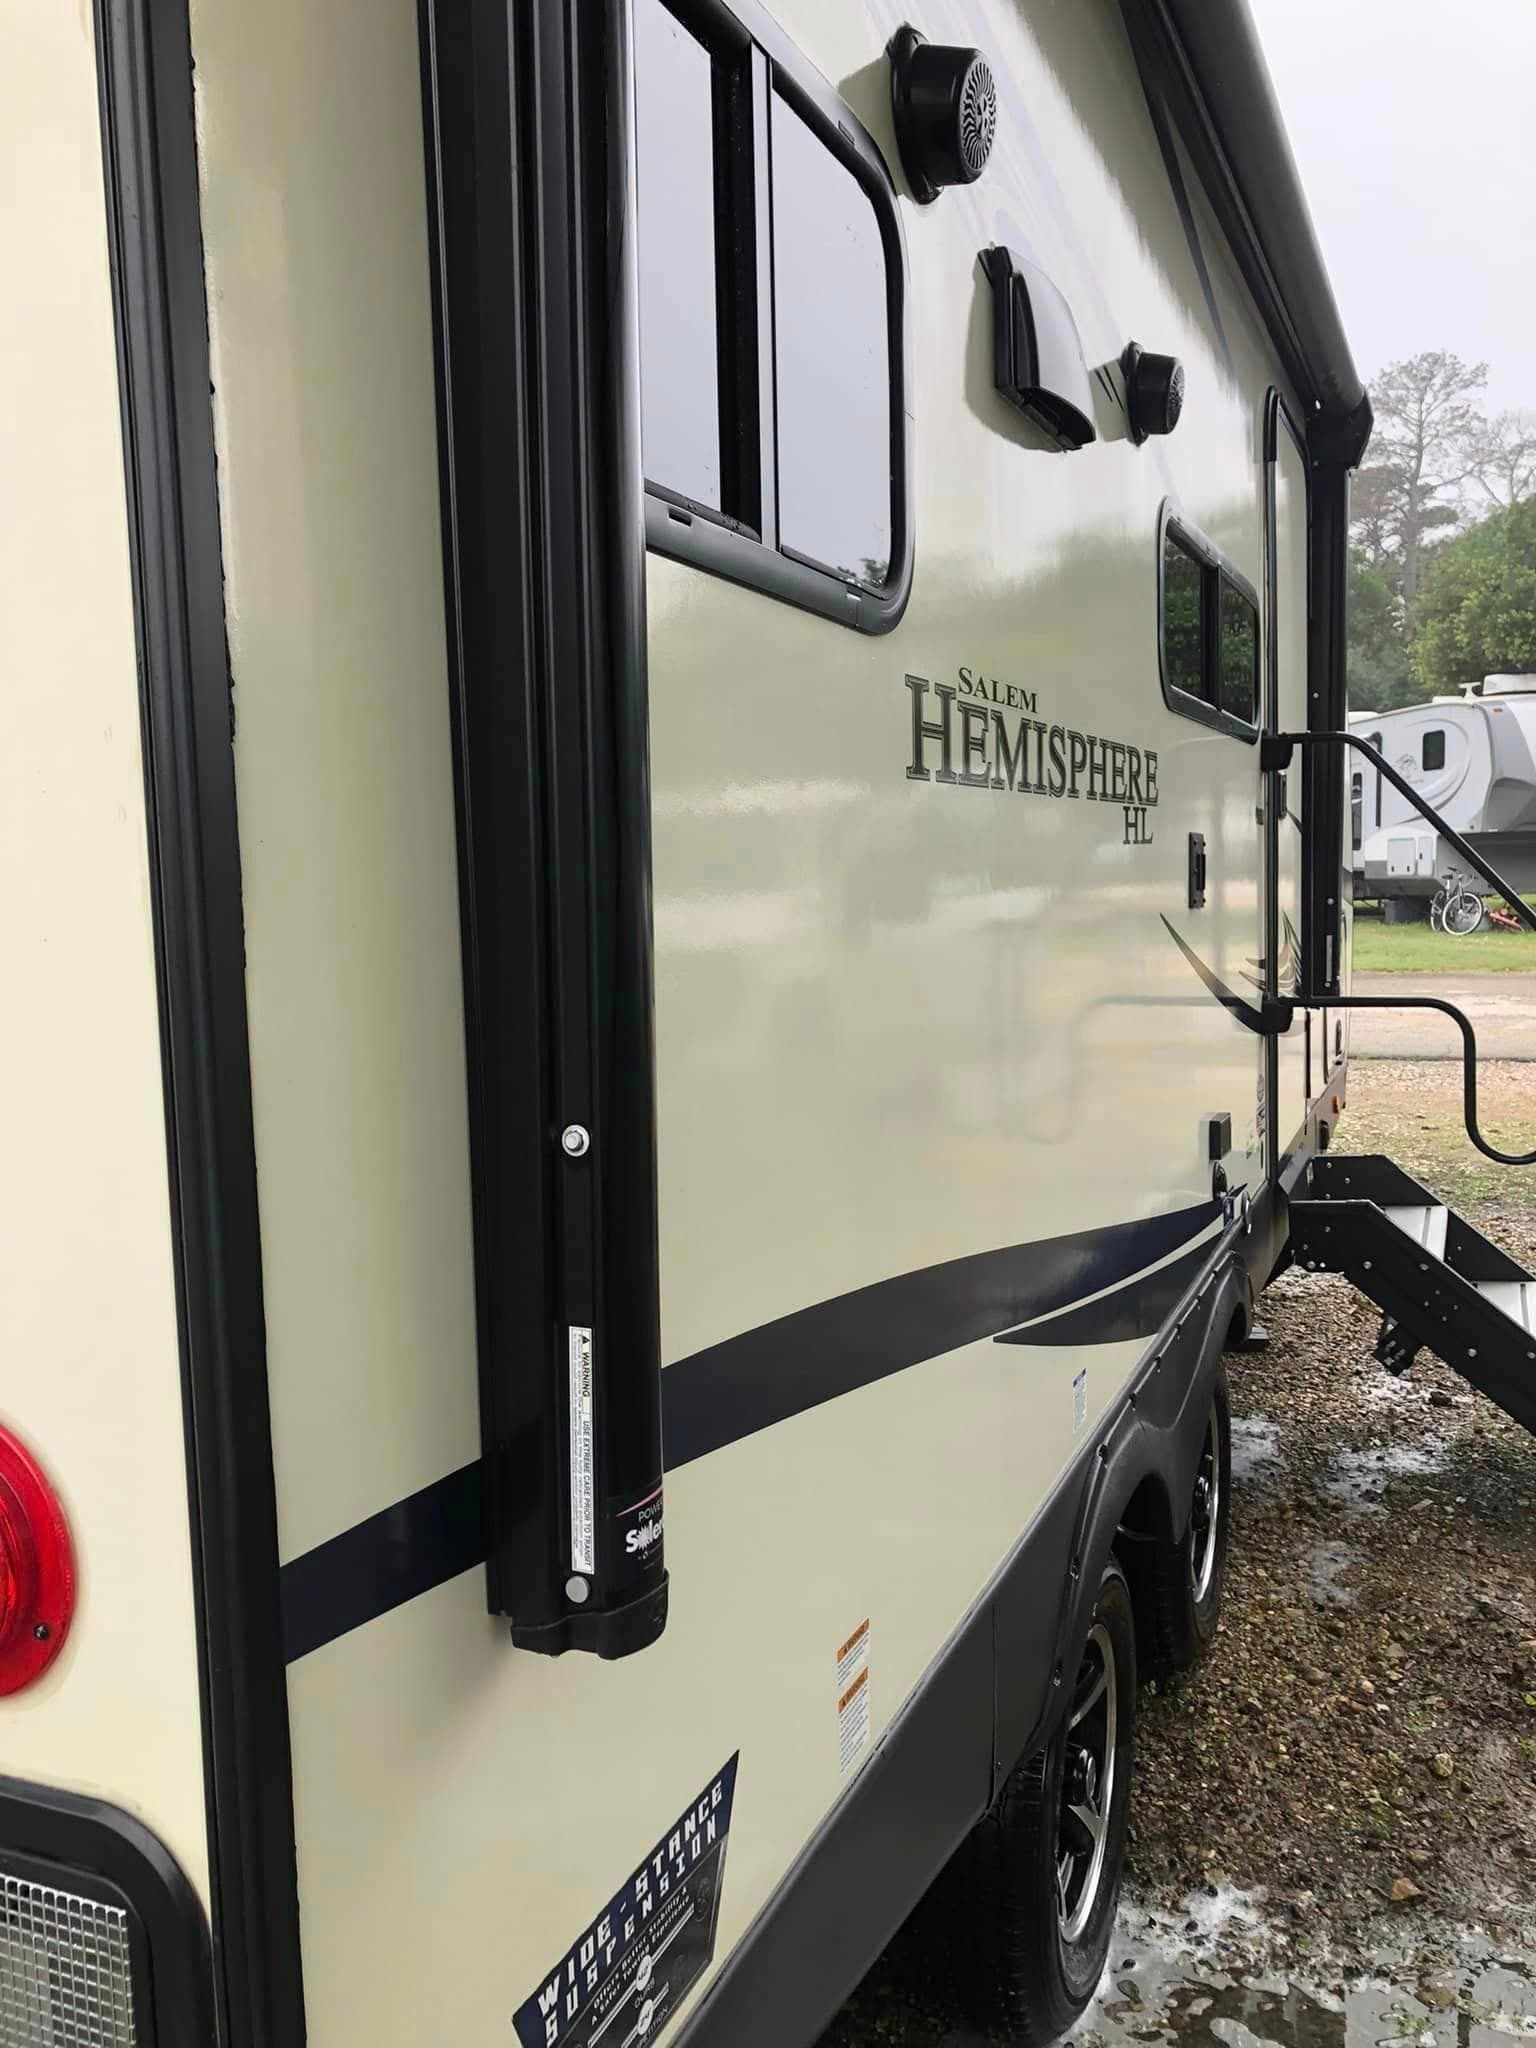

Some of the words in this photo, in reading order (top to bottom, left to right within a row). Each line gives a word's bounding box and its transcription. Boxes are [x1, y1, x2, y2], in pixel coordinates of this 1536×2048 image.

[958, 667, 1038, 713] SALEM
[904, 673, 1159, 807] HEMISPHERE
[1122, 806, 1153, 845] HL
[582, 1351, 591, 1398] WARNING
[583, 1420, 591, 1435] USE
[545, 1813, 717, 2048] SUSPENSION
